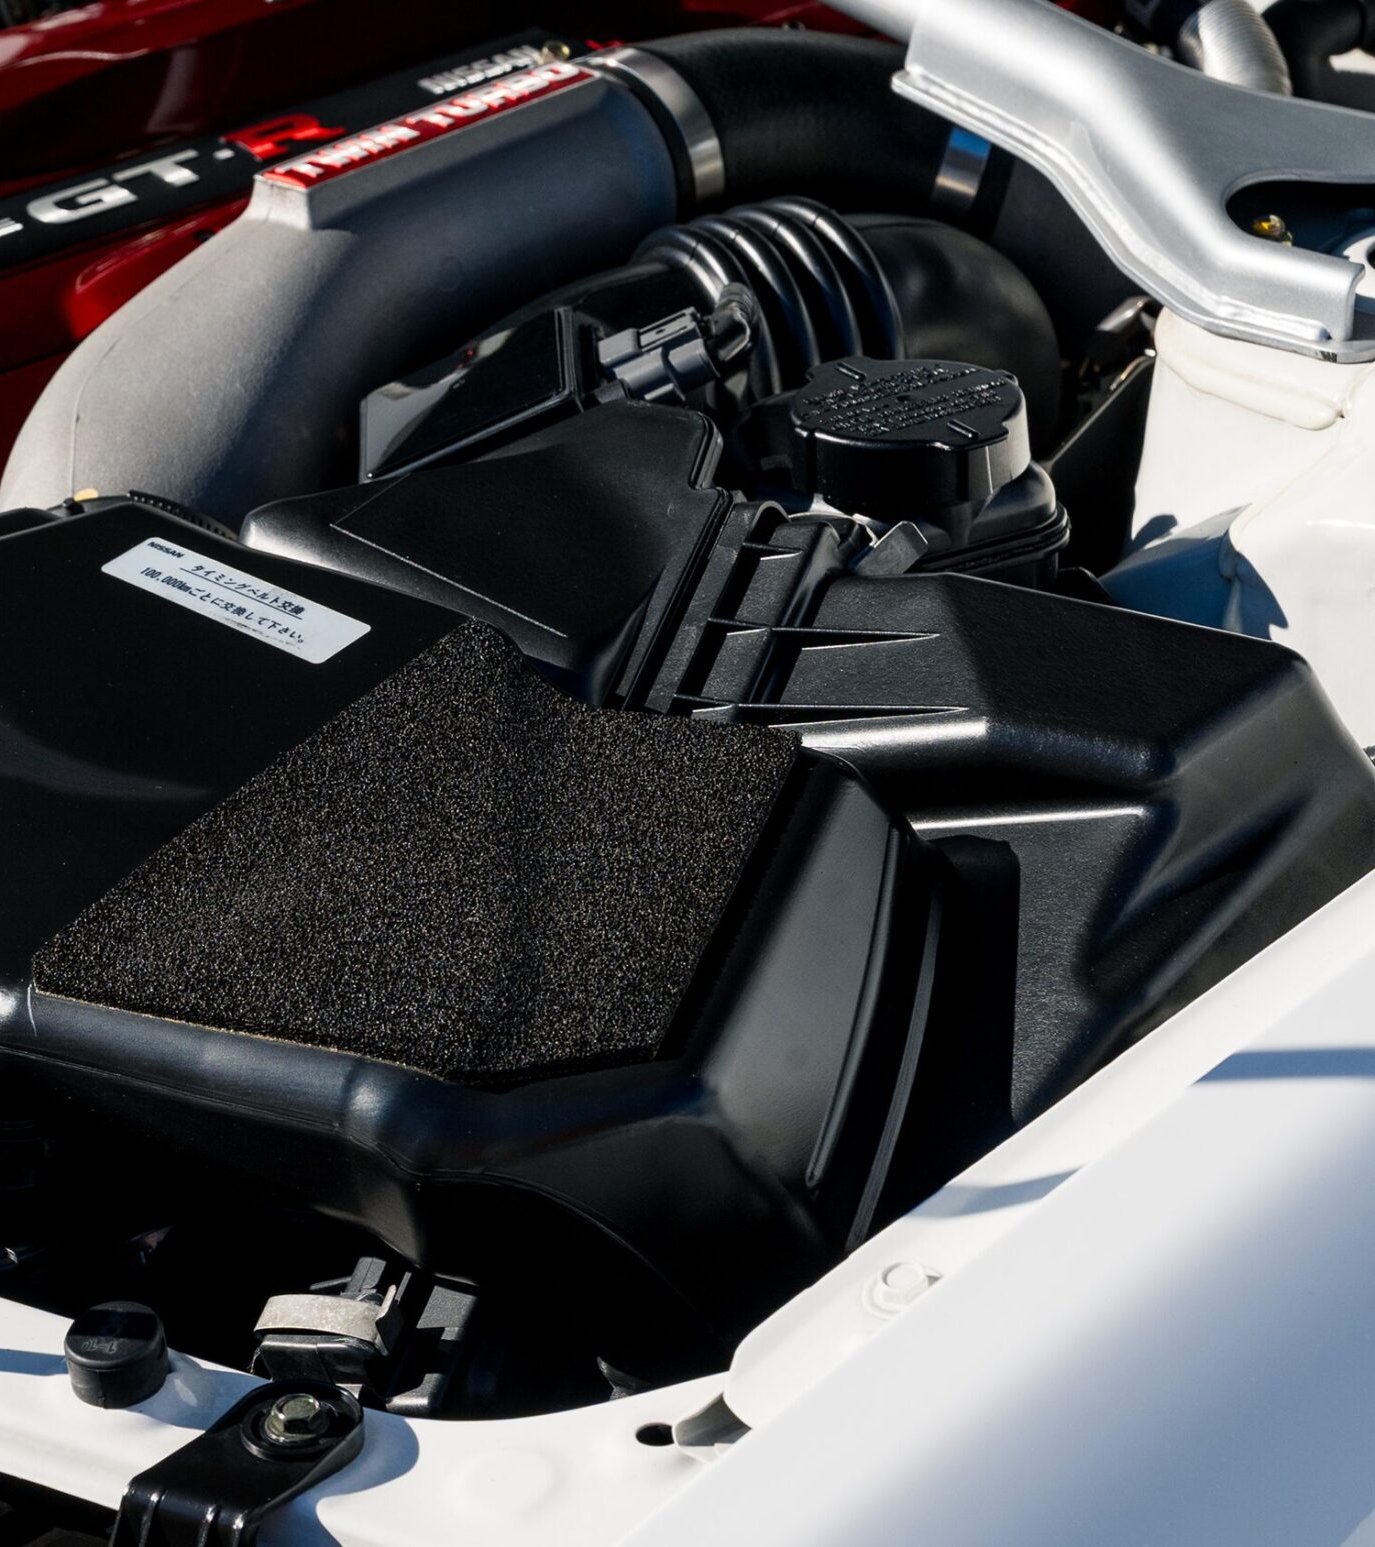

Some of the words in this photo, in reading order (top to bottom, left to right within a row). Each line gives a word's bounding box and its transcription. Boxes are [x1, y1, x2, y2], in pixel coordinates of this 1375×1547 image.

[418, 44, 541, 94] NISSAN
[274, 123, 421, 178] TWIN
[406, 62, 581, 128] TURBO
[147, 541, 185, 558] NISSAN
[192, 564, 305, 615] タイミングベルト交換
